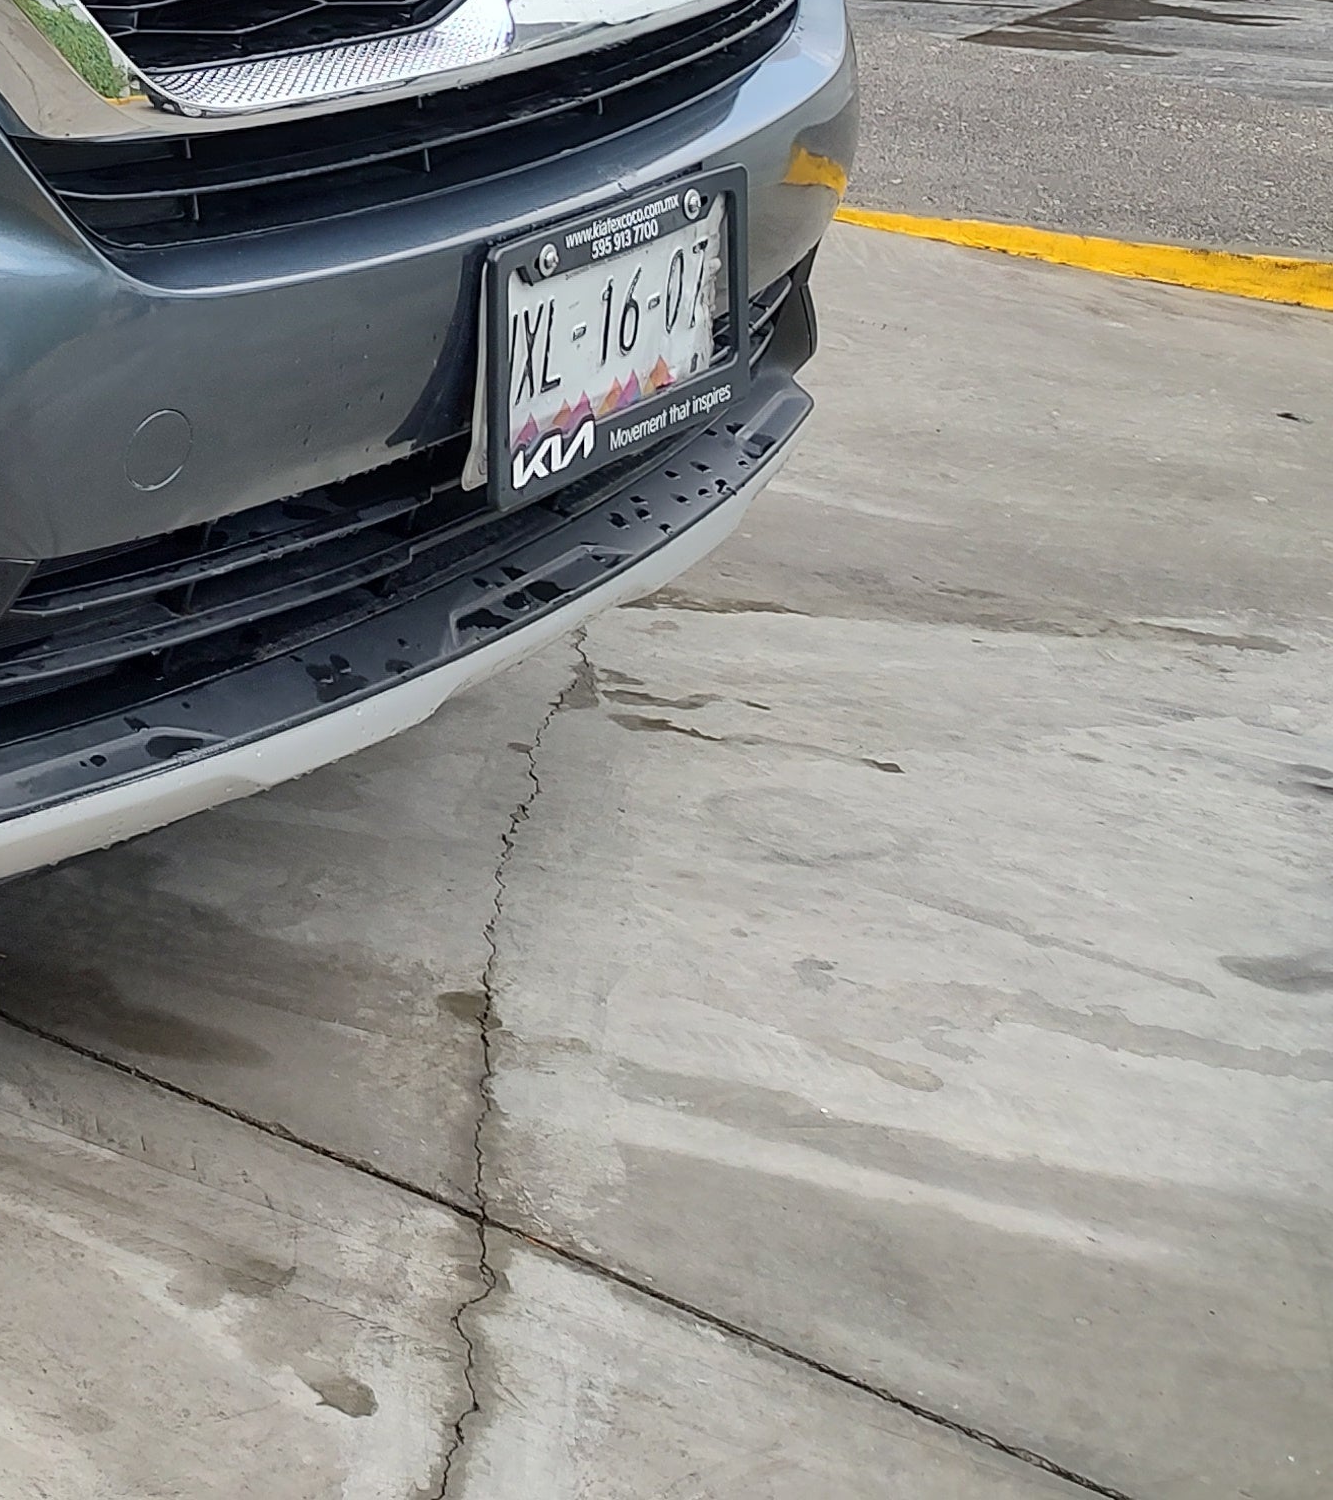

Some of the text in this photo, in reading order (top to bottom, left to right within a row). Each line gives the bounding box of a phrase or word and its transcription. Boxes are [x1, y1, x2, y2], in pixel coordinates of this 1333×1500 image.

[591, 236, 613, 260] 595
[614, 228, 632, 252] 913
[633, 218, 659, 245] 7700
[609, 383, 732, 451] Movement that inspires
[513, 420, 595, 490] KIA
